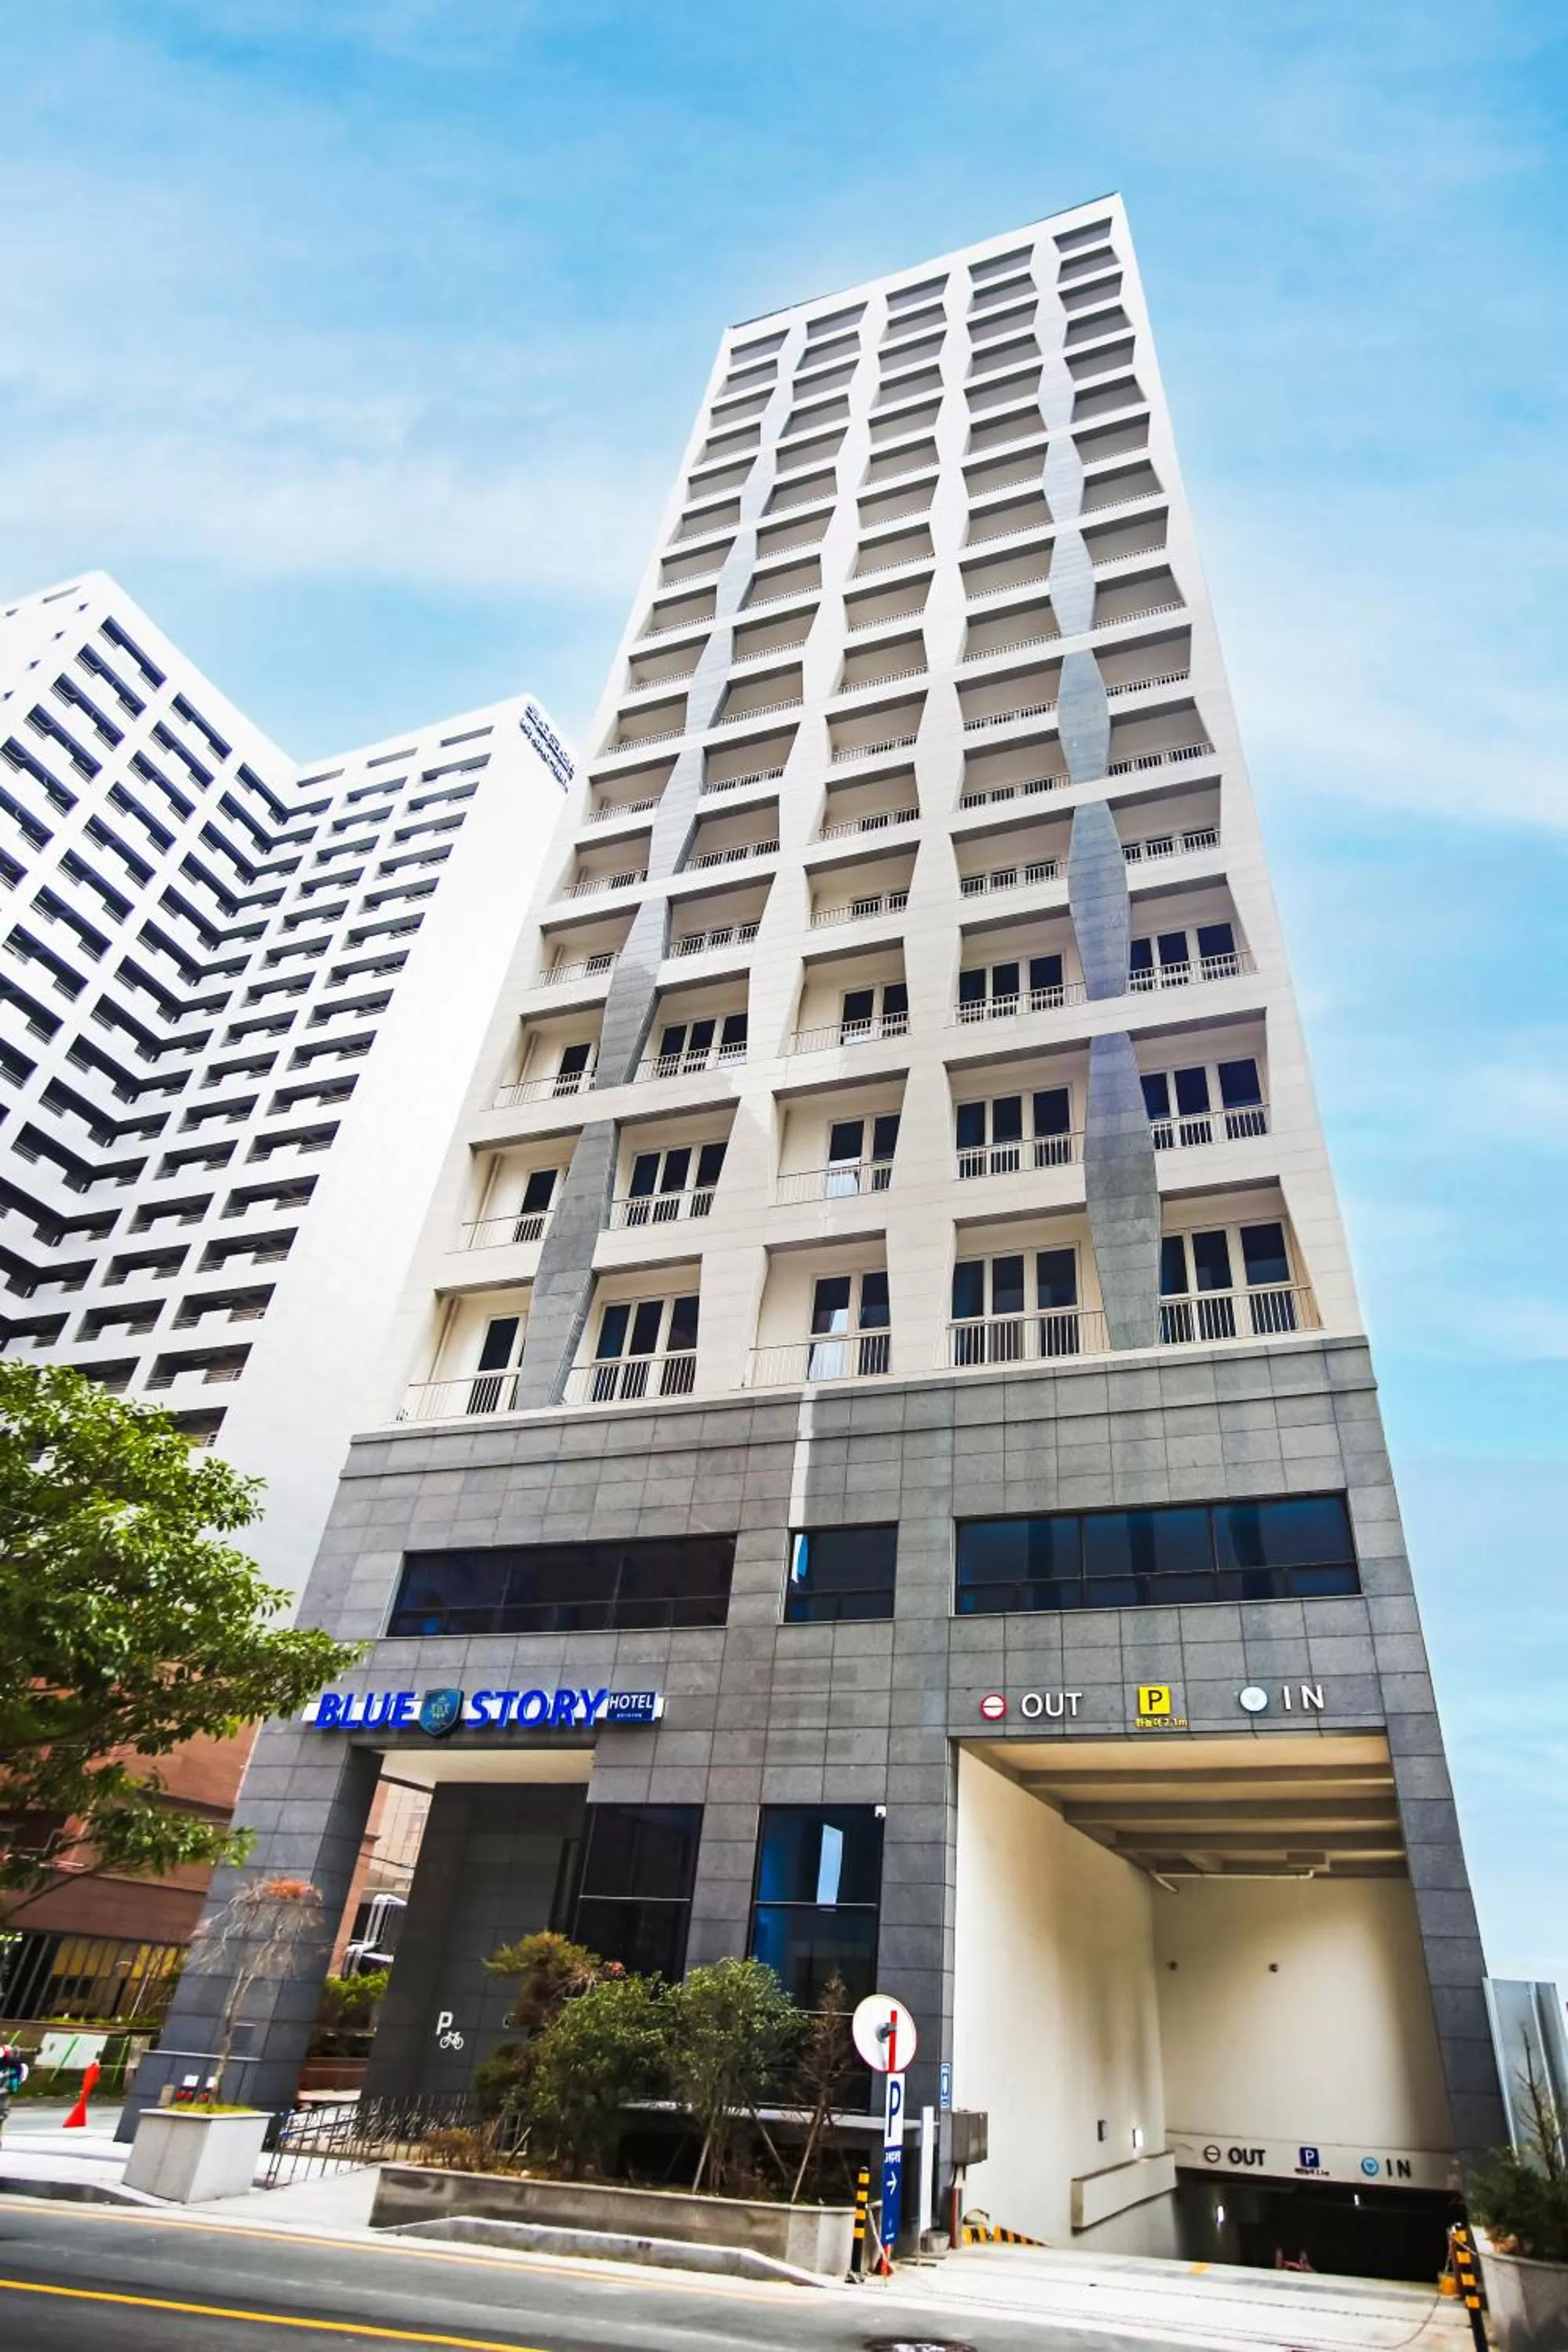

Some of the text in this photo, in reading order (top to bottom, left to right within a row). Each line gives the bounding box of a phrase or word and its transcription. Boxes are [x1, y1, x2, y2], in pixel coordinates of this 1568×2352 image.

[609, 1694, 652, 1709] HOTEL
[1021, 1692, 1083, 1718] OUT
[1148, 1689, 1163, 1711] P
[1283, 1684, 1325, 1710] IN
[314, 1688, 608, 1729] BLUE STORY
[436, 2012, 453, 2035] P
[887, 2080, 902, 2138] P
[1227, 2147, 1266, 2167] OUT
[1304, 2149, 1316, 2165] P
[1385, 2158, 1411, 2179] IN
